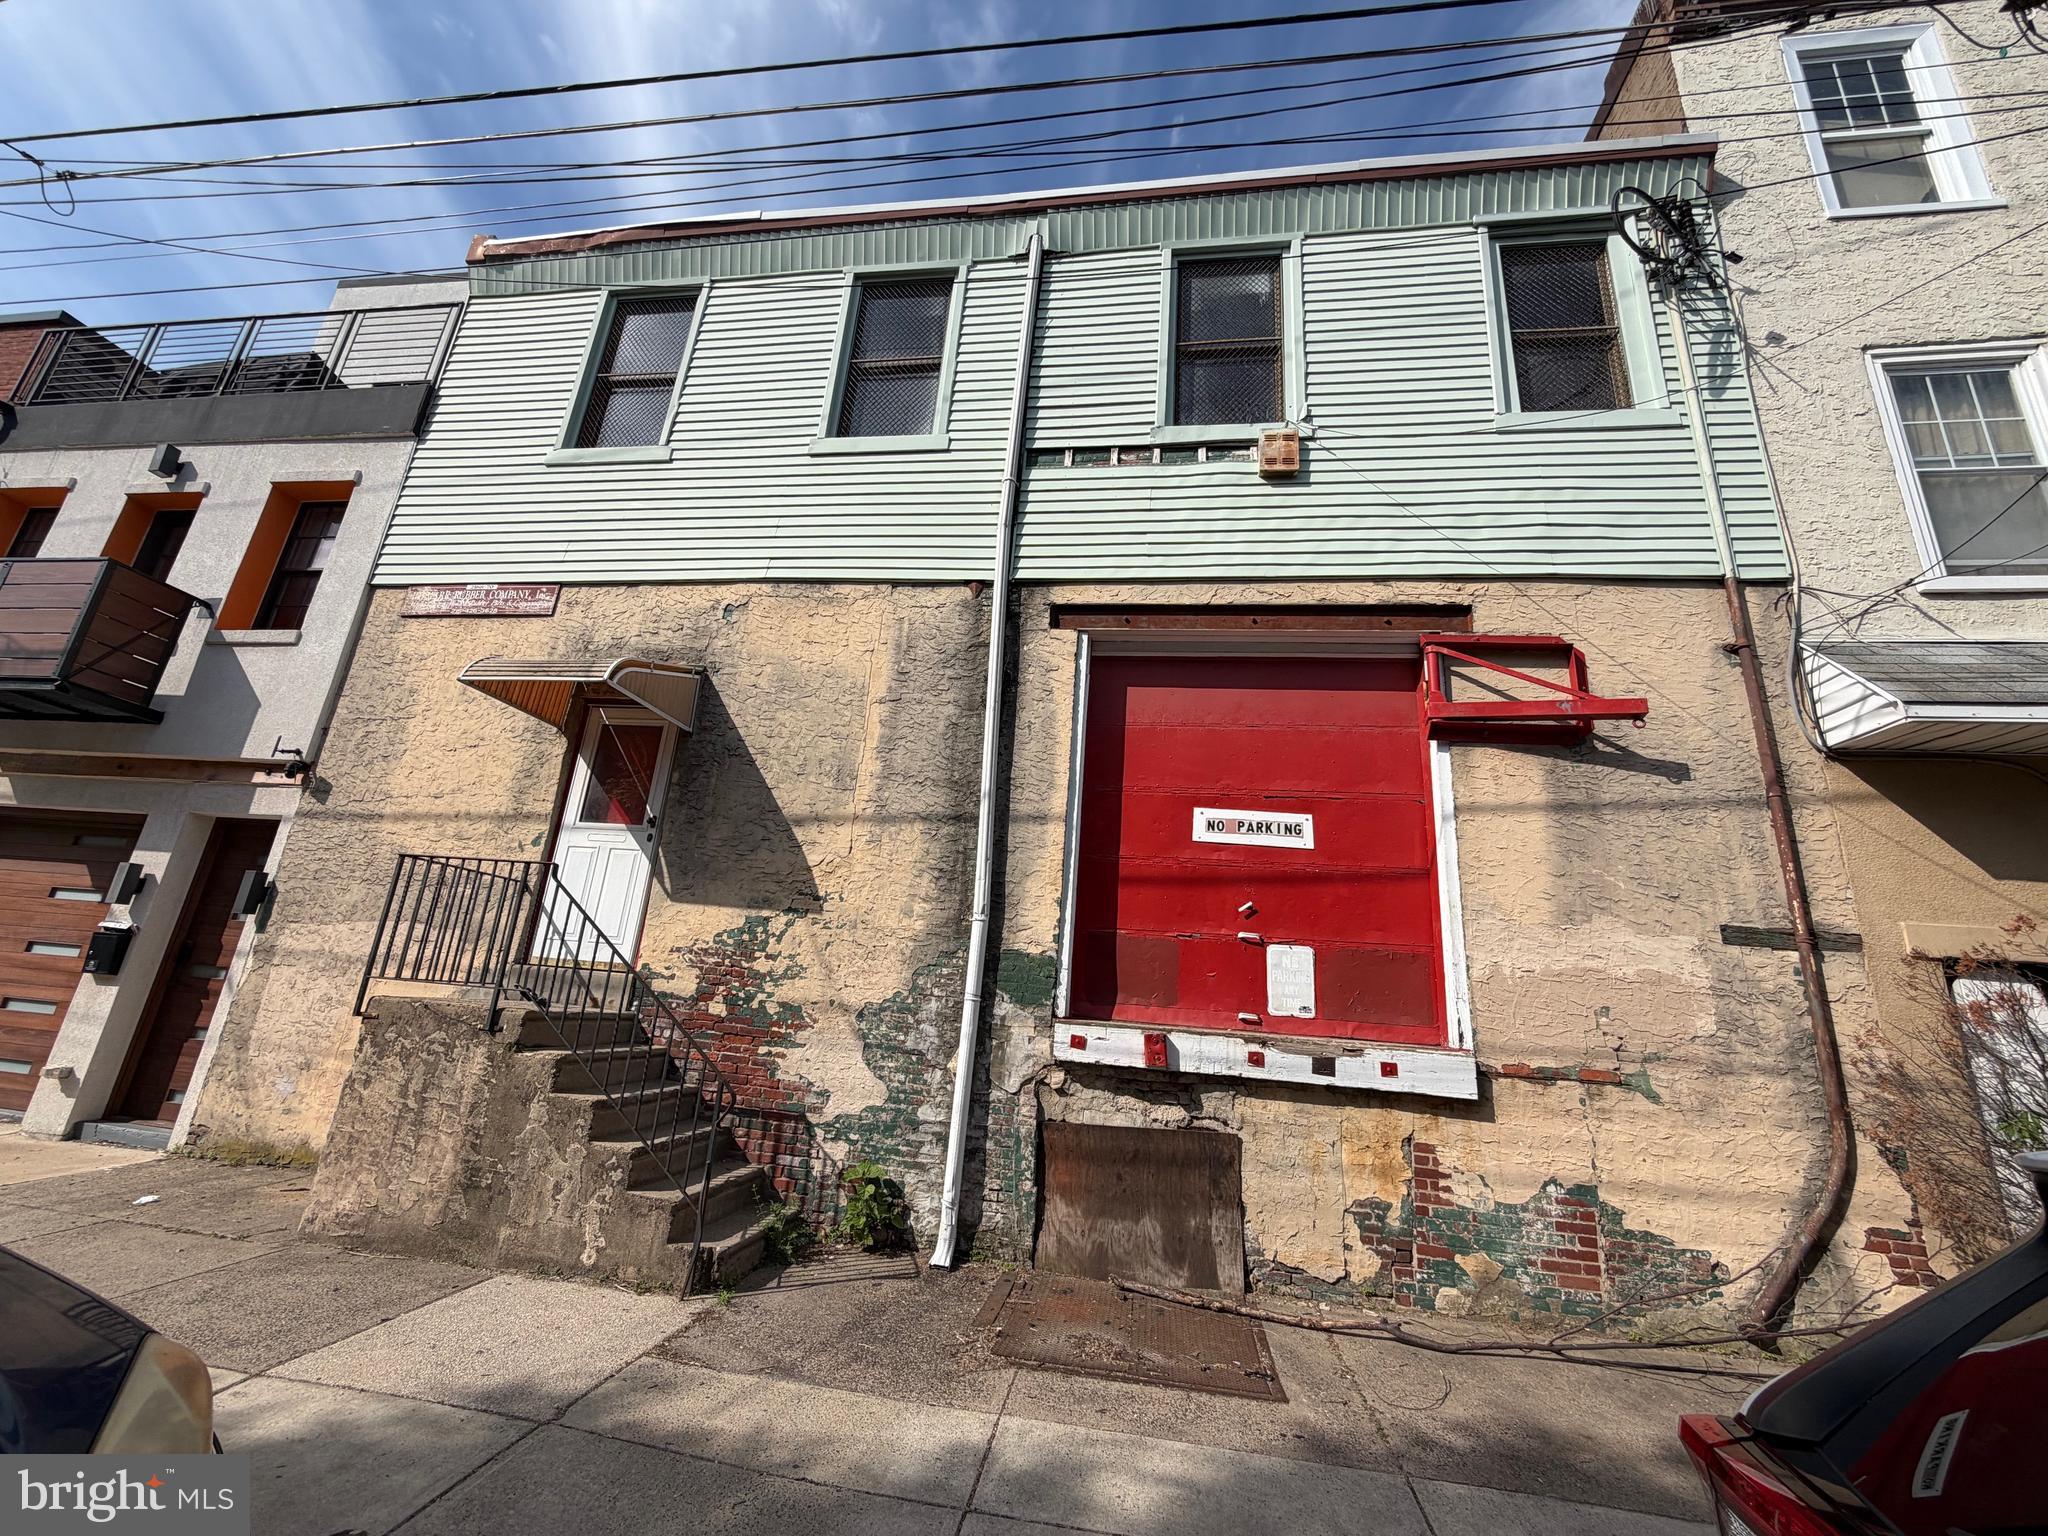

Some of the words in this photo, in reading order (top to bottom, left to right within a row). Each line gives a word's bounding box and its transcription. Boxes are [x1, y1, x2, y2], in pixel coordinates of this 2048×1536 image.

[454, 589, 486, 600] RUBBER
[489, 589, 532, 600] COMPANY,
[1207, 820, 1225, 832] NO
[1237, 821, 1302, 836] PARKING
